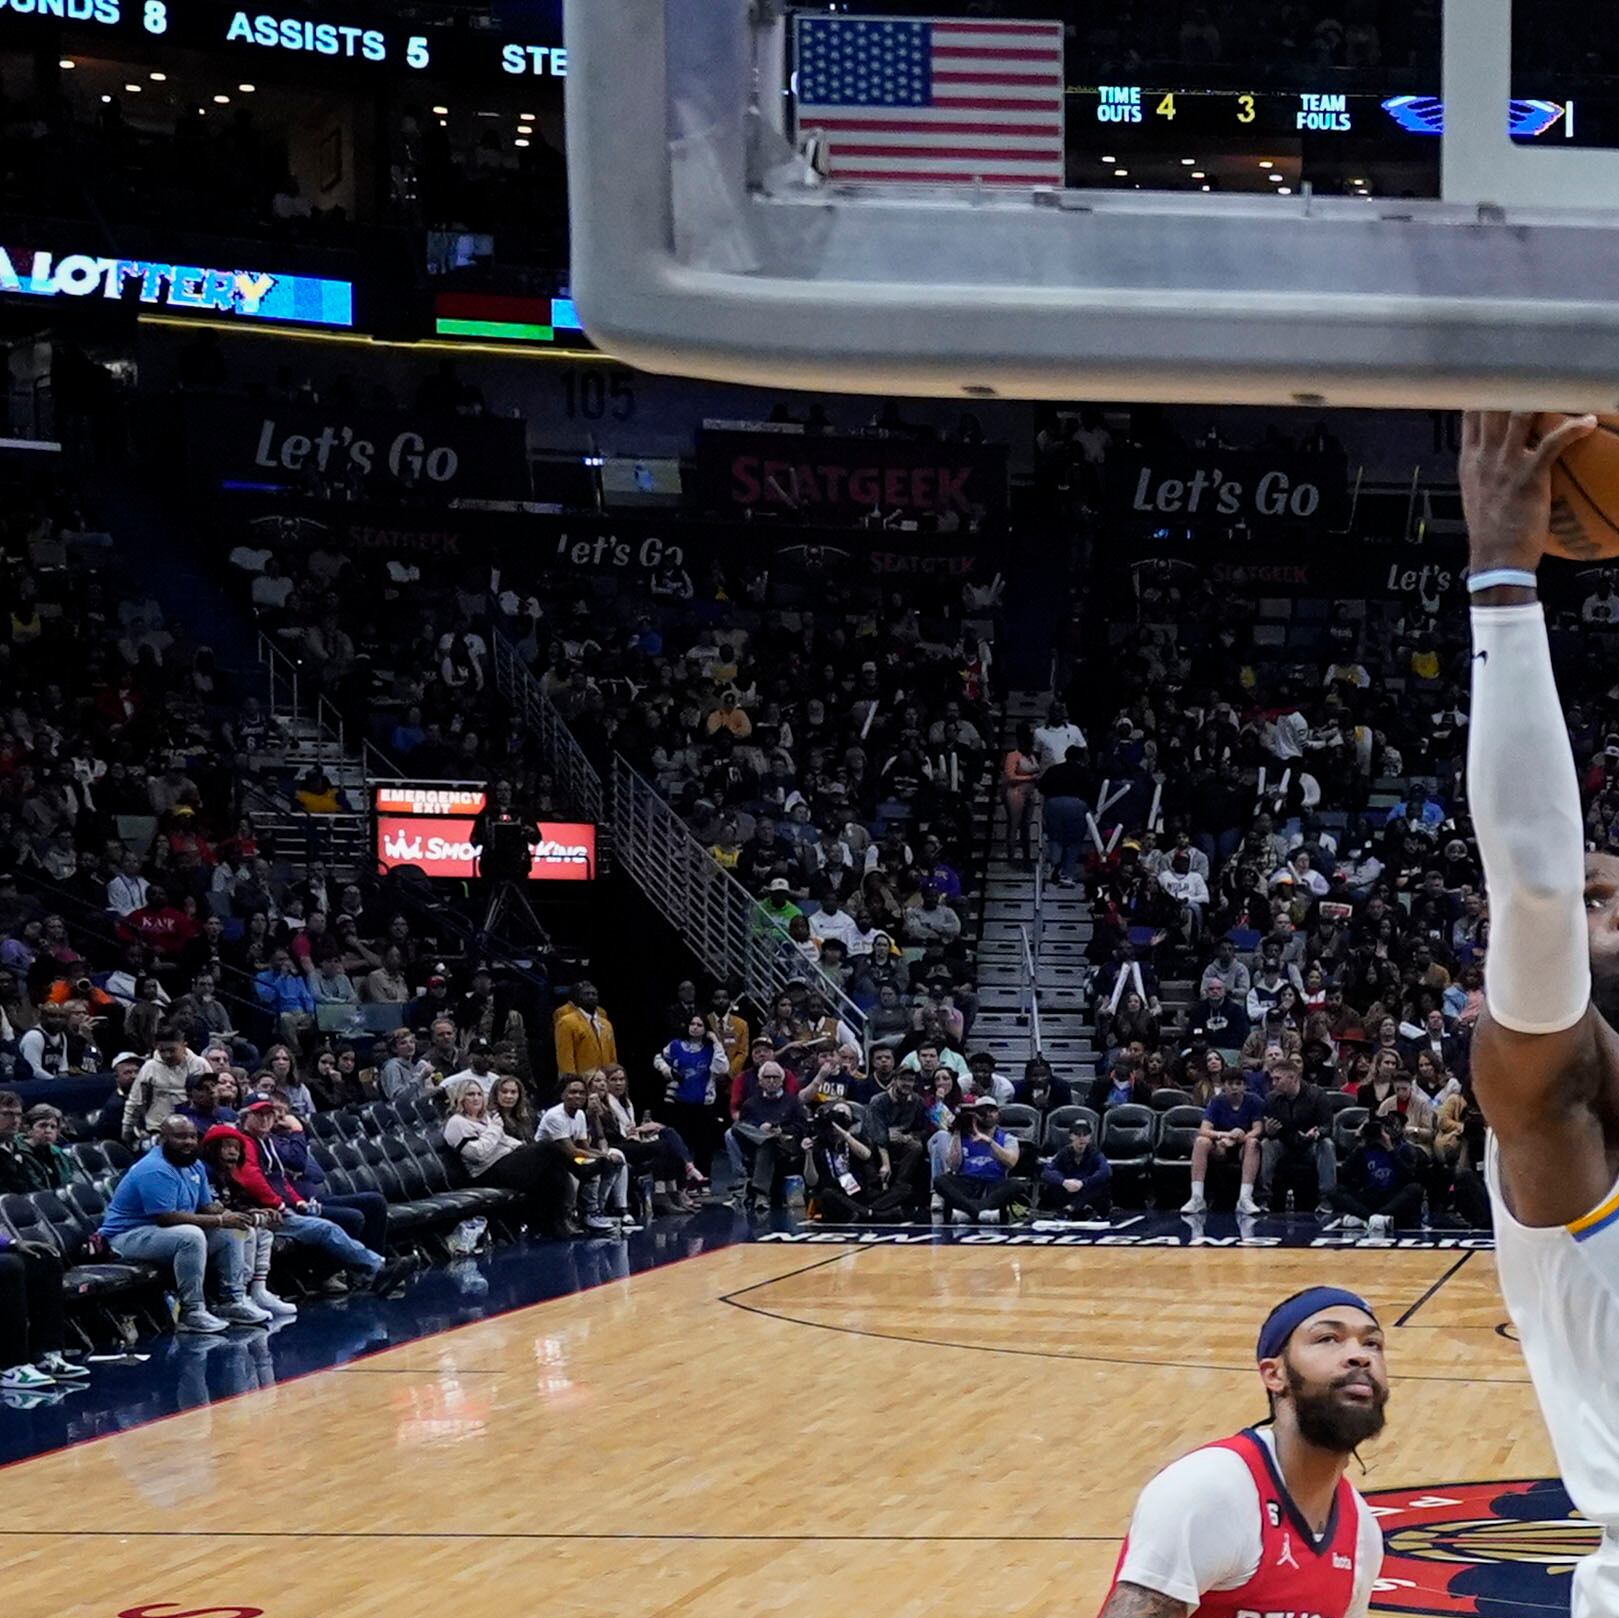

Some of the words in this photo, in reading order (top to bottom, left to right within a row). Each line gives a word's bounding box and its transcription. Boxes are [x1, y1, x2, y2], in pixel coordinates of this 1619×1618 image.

[144, 0, 169, 36] 8
[227, 12, 387, 62] ASSISTS
[407, 37, 431, 69] 5
[1097, 86, 1142, 105] TIME
[1155, 94, 1177, 121] 4
[1237, 94, 1257, 124] 3
[1299, 94, 1347, 114] TEAM
[1097, 103, 1143, 123] OUTS
[1296, 111, 1352, 132] FOULS
[31, 250, 277, 313] LOTTERY
[561, 369, 635, 422] 105
[255, 419, 376, 475] Let's
[387, 432, 459, 483] Go
[730, 454, 975, 514] SEATGEEK
[1131, 466, 1242, 514] Let's
[1255, 470, 1321, 517] Go
[1386, 562, 1452, 592] Let's
[380, 788, 484, 806] EMERGENCY
[412, 802, 451, 814] EXIT
[425, 836, 482, 861] SMO
[757, 1230, 938, 1244] NEW
[958, 1235, 1282, 1249] ORLEANS
